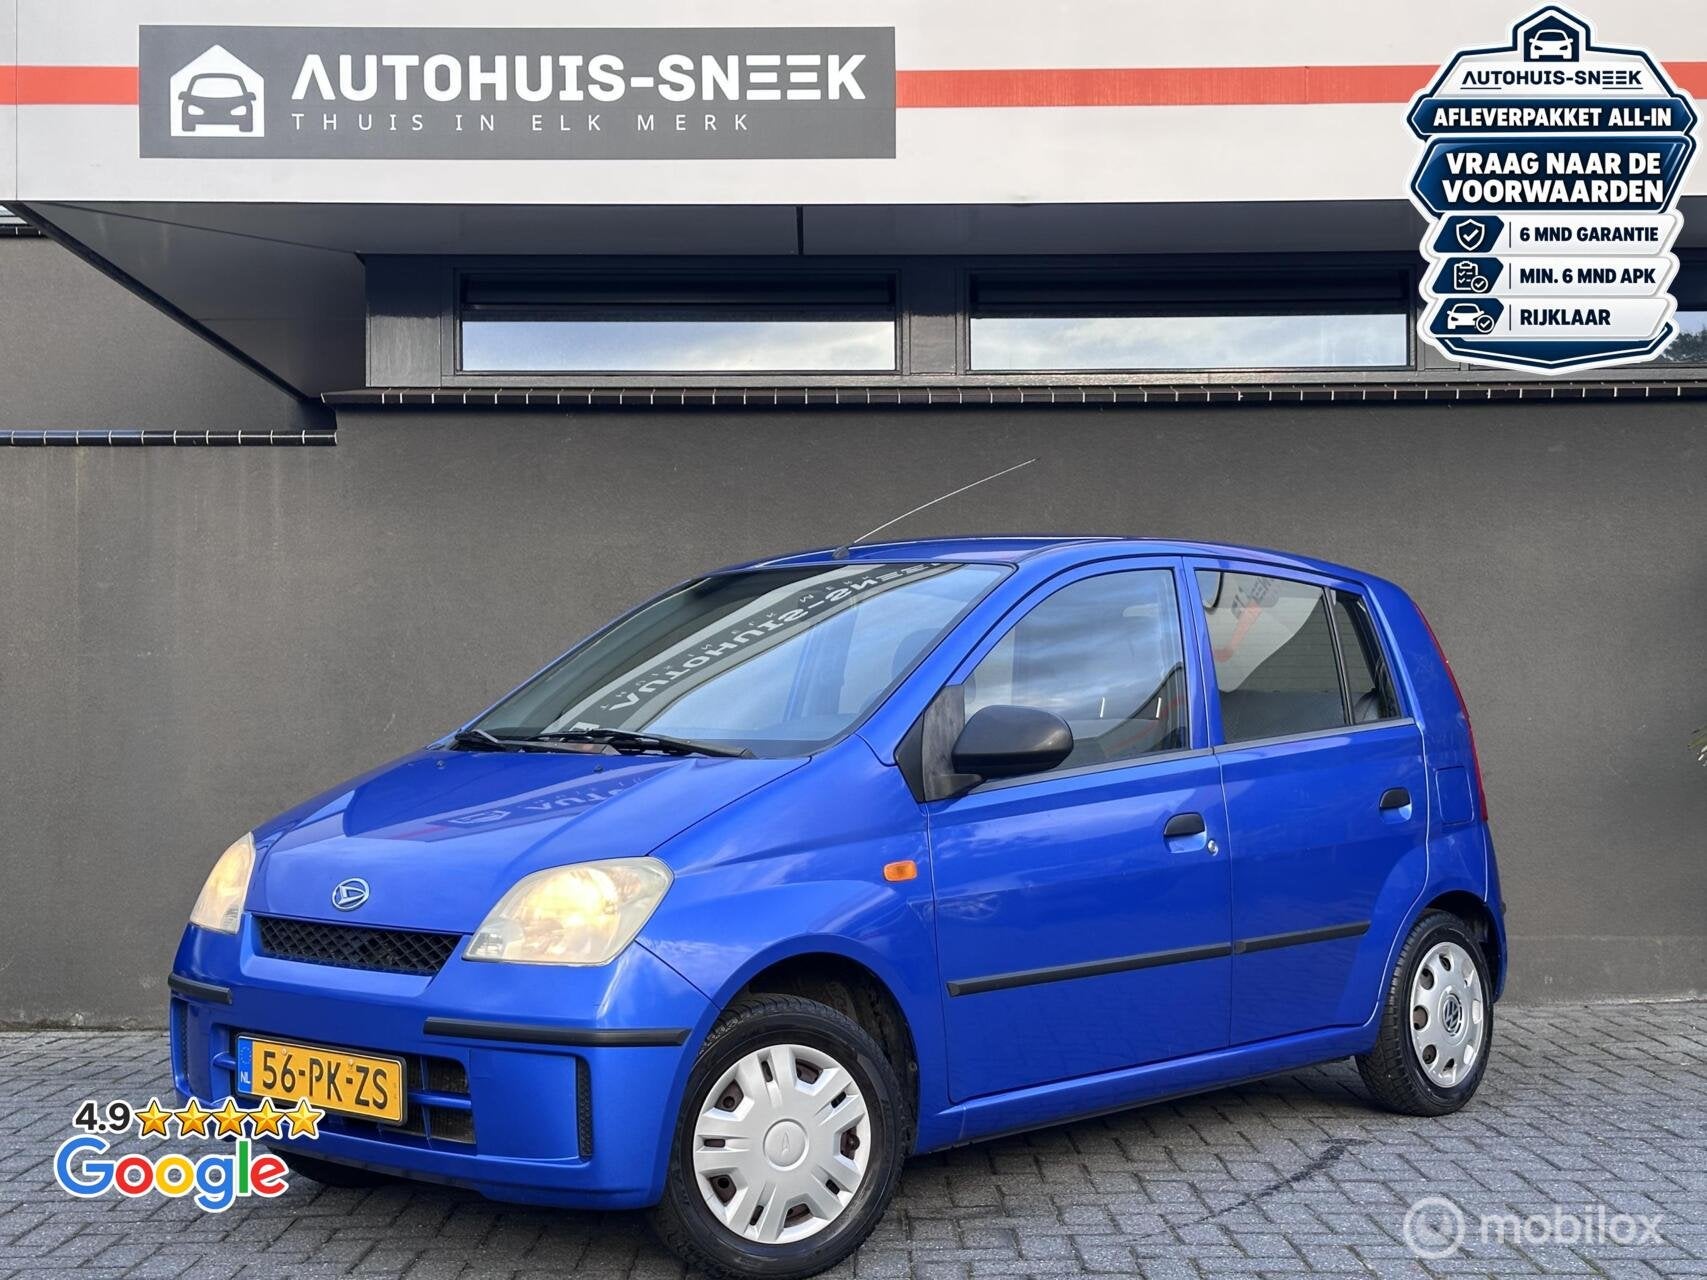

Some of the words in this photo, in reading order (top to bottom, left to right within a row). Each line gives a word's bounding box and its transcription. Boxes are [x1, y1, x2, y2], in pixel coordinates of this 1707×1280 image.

[291, 53, 867, 102] AUTOHUIS-SNEEK
[291, 113, 424, 132] THUIS
[456, 113, 495, 132] IN
[531, 113, 602, 132] ELK
[637, 112, 749, 131] MERK
[240, 1070, 251, 1085] NL
[261, 1049, 389, 1111] 56-PK-ZS
